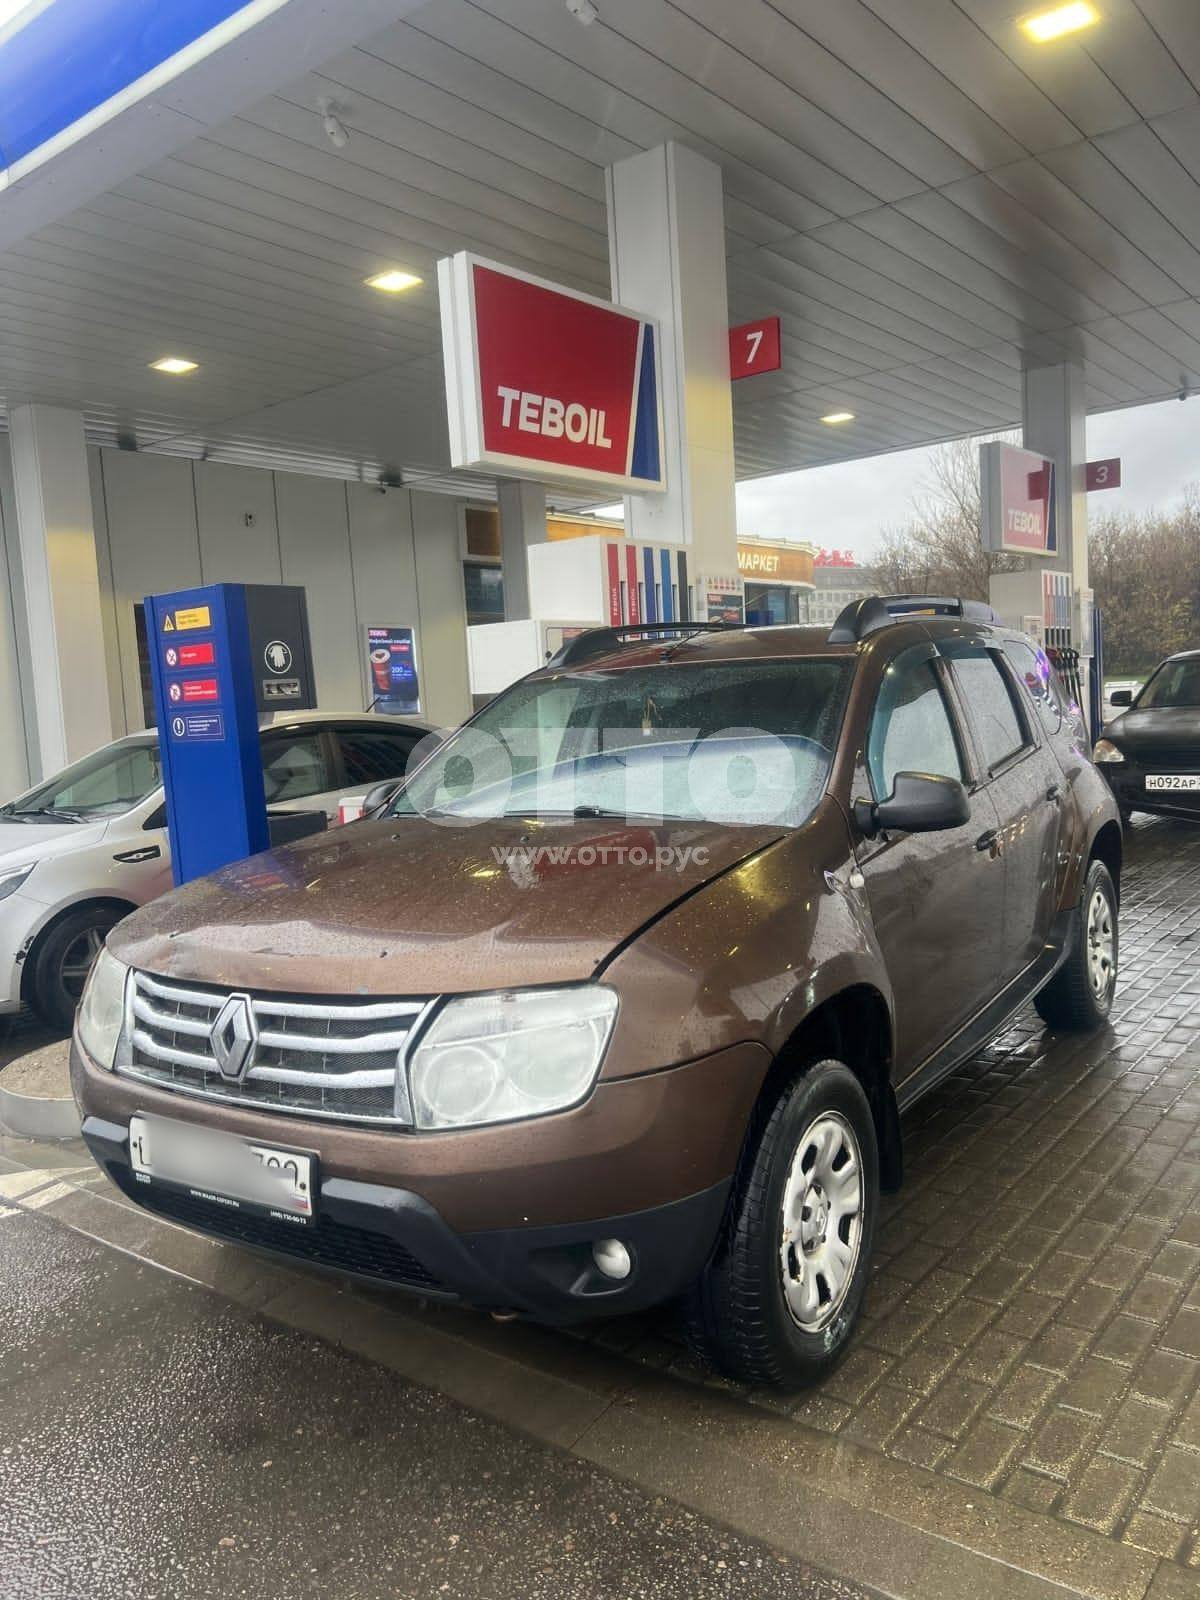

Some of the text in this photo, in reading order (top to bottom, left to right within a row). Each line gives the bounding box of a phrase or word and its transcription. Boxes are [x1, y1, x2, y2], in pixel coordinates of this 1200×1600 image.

[746, 331, 763, 364] 7
[497, 386, 612, 449] TEBOIL
[1095, 466, 1109, 484] 3
[1008, 508, 1043, 536] TEBOIL
